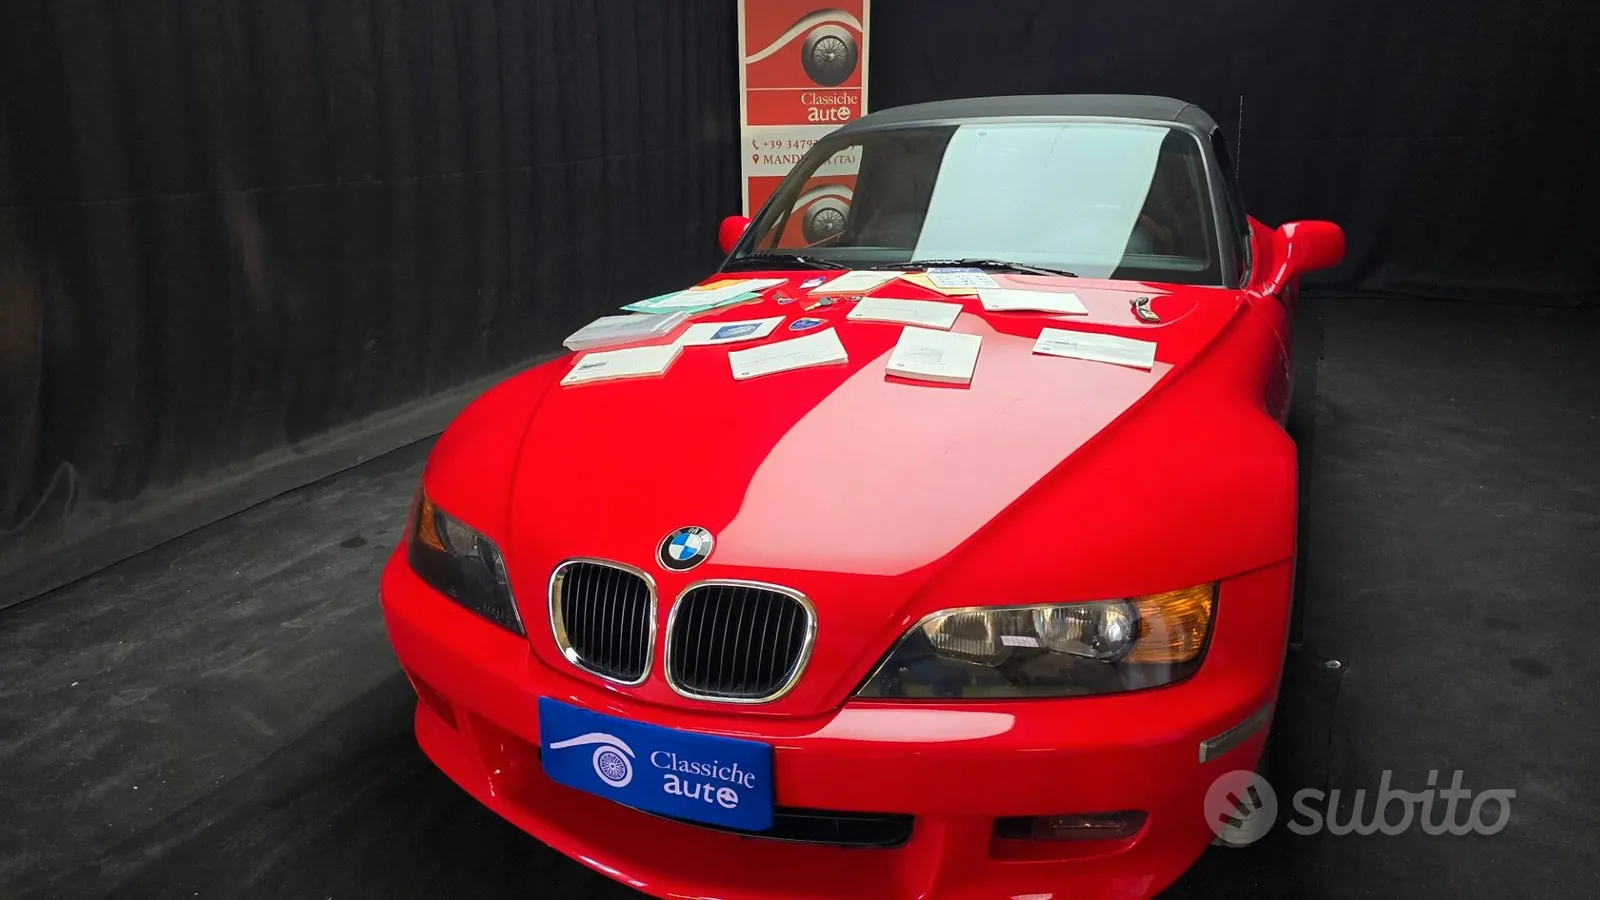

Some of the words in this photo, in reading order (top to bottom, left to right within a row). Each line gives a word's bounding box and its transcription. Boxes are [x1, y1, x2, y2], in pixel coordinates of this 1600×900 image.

[801, 92, 857, 105] Classiche
[763, 140, 782, 150] +39
[834, 155, 856, 166] (TA)
[650, 750, 755, 789] Classiche
